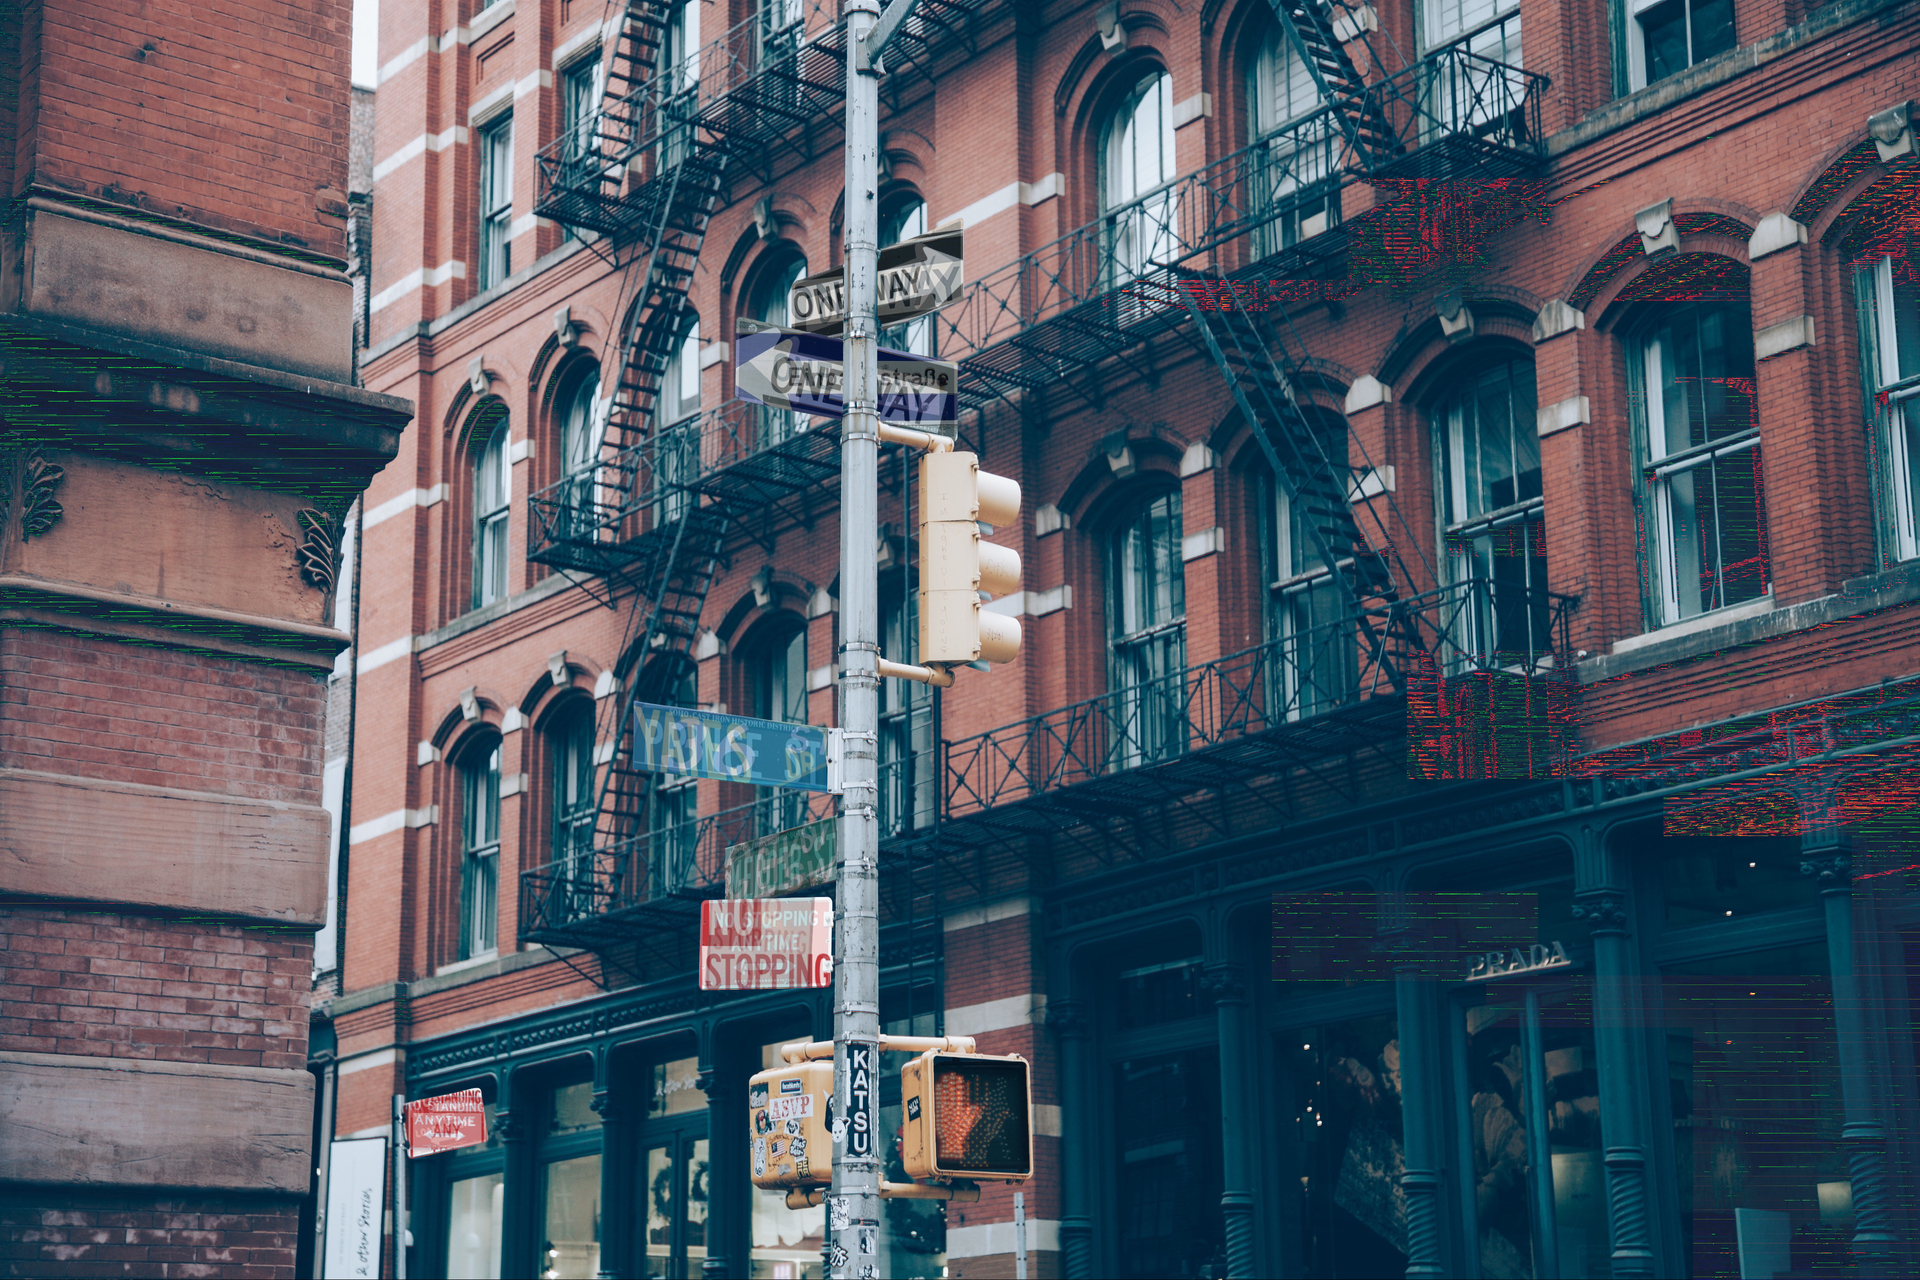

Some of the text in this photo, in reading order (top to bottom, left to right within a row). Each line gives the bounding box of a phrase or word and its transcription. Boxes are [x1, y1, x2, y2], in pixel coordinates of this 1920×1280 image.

[712, 715, 731, 723] IRON
[731, 718, 766, 728] HISTORIC
[1466, 941, 1569, 979] PRADA
[771, 1096, 809, 1119] ASVP
[853, 1050, 868, 1153] KATSU
[414, 1114, 476, 1127] ANYTIME
